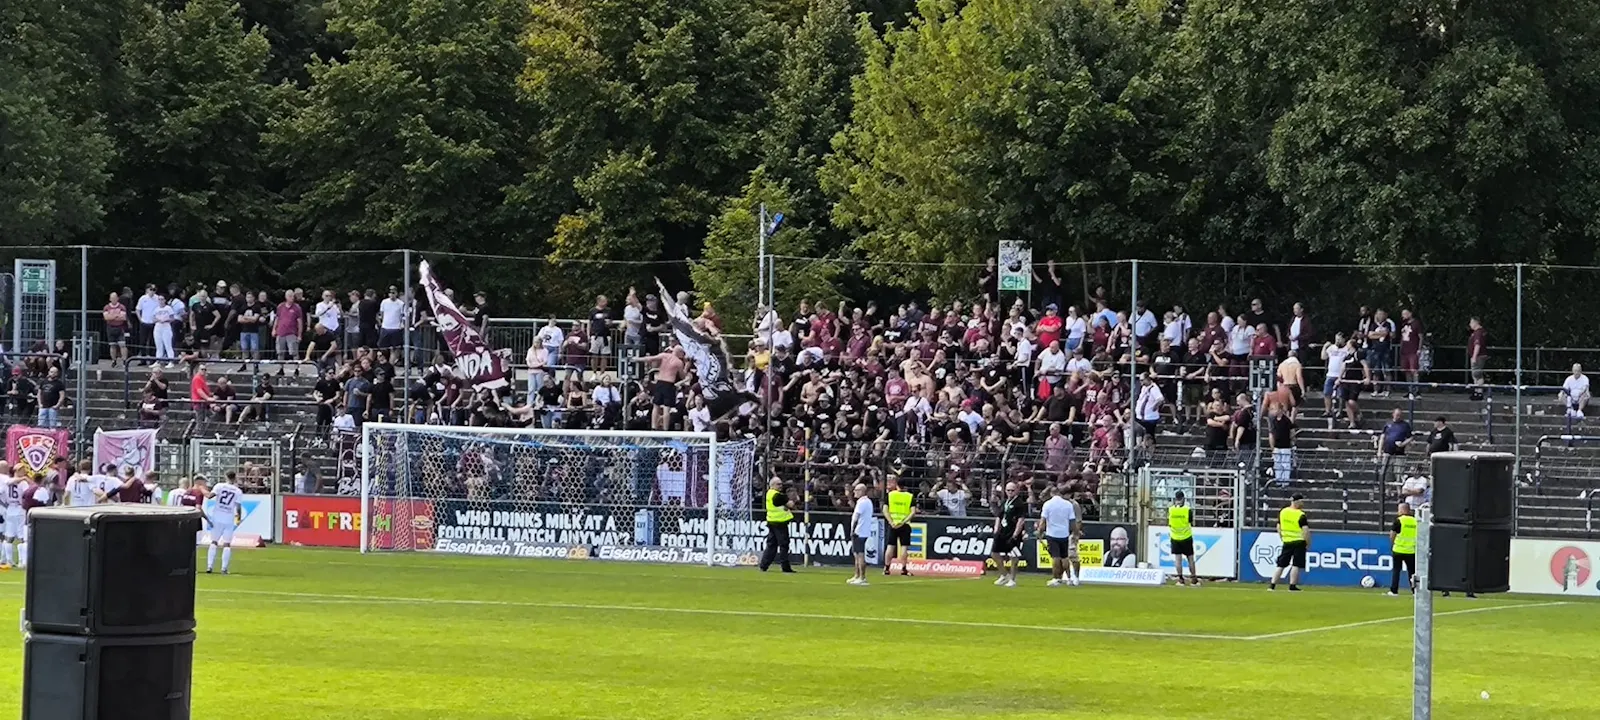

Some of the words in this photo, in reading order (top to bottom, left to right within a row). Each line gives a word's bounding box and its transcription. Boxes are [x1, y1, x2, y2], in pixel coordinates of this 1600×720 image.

[205, 450, 214, 465] 3
[8, 484, 19, 499] 16
[219, 490, 236, 506] 27
[286, 510, 324, 529] EAT
[327, 512, 391, 531] FREH
[456, 510, 490, 526] WHO
[493, 511, 543, 529] DRINKS
[546, 513, 582, 530] MILK
[584, 515, 604, 531] AT
[605, 516, 616, 531] A
[717, 519, 770, 536] DRINKS
[812, 523, 833, 539] AT
[834, 523, 846, 540] A
[438, 525, 506, 541] FOOTBALL
[507, 527, 556, 544] MATCH
[559, 530, 630, 547] ANYWAY?
[660, 533, 730, 550] FOOTBLL
[788, 539, 853, 556] ANYWAY
[436, 539, 510, 556] Eisenbach
[599, 545, 678, 561] Eisenbach
[1160, 537, 1207, 562] SP
[932, 562, 977, 574] Oelmann
[1305, 547, 1394, 572] peRCo
